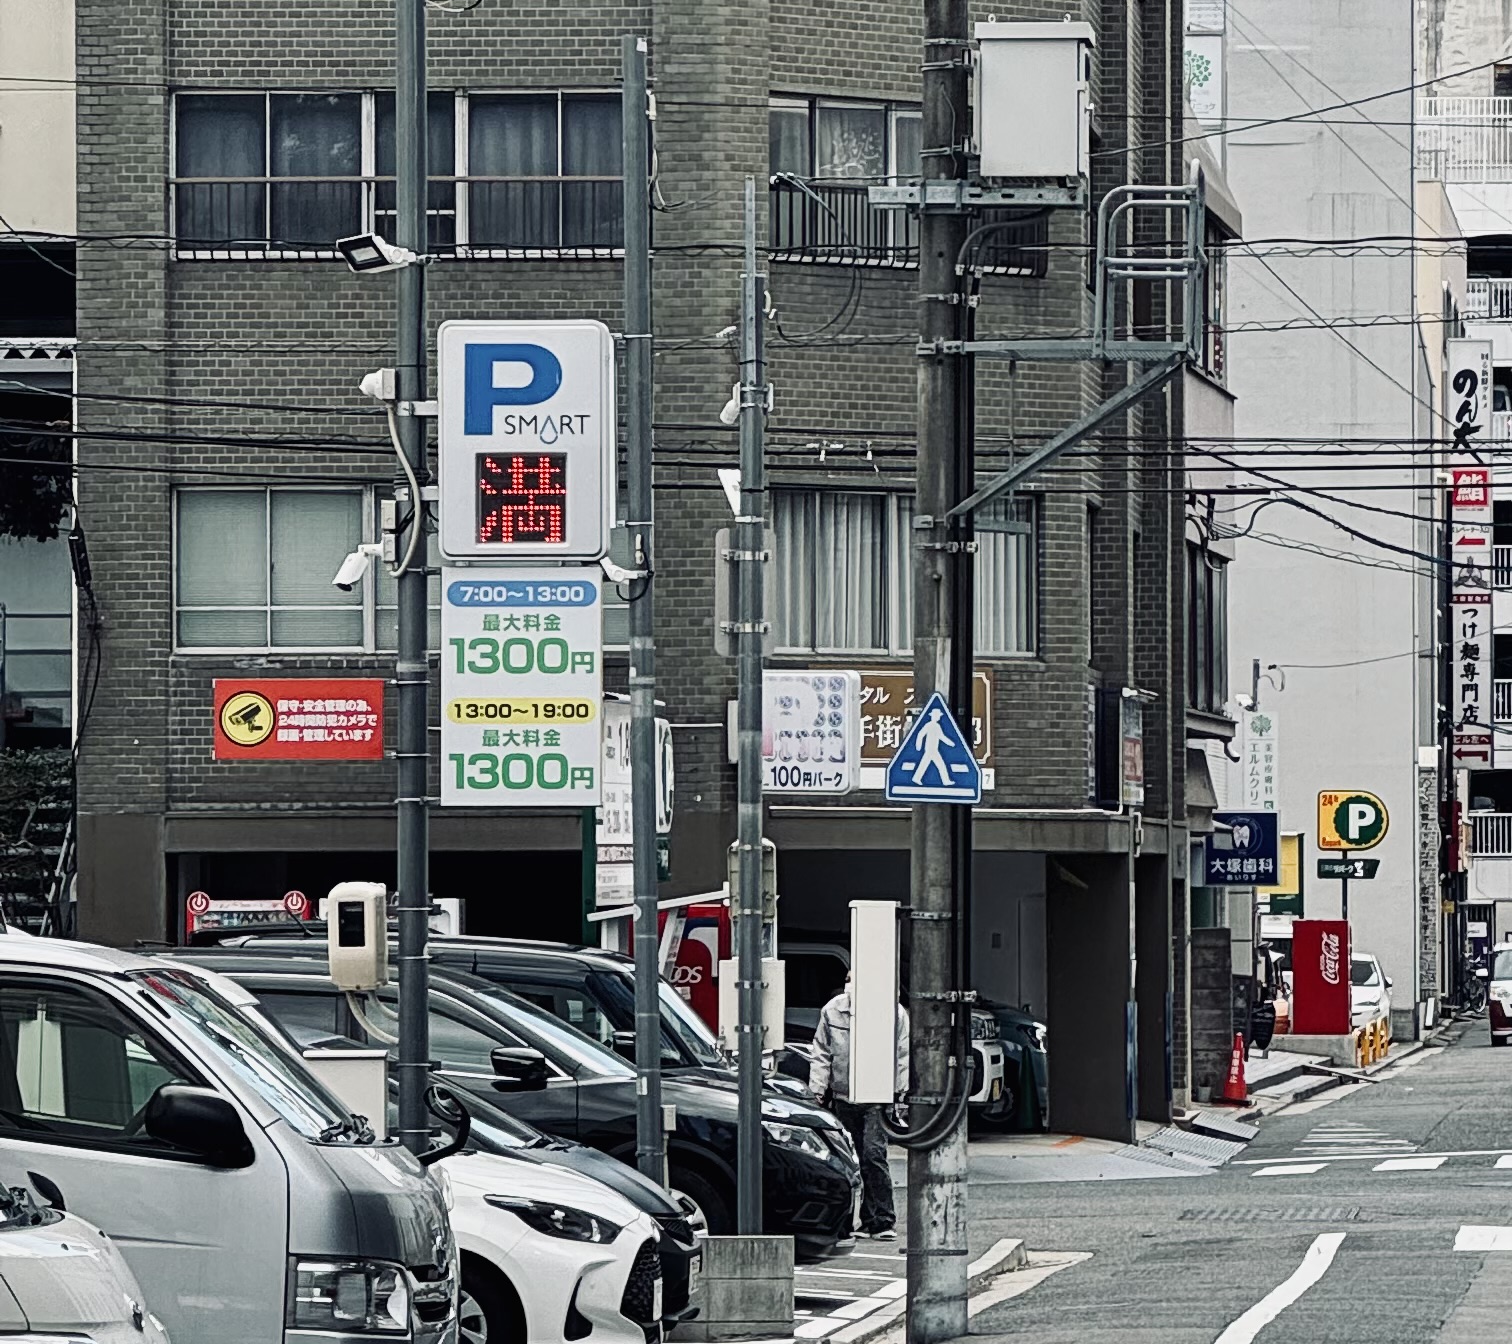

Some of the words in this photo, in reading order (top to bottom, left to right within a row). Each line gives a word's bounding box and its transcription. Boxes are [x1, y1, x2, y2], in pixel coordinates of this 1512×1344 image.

[464, 343, 563, 436] P
[504, 414, 591, 445] SMART
[480, 457, 566, 543] 満
[1456, 474, 1485, 502] 鮨
[482, 613, 562, 632] 最大料金
[449, 637, 595, 674] 1300円
[482, 729, 561, 748] 最大料金
[449, 752, 595, 790] 1300円
[1348, 803, 1376, 840] P
[1210, 858, 1273, 873] 大塚歯科
